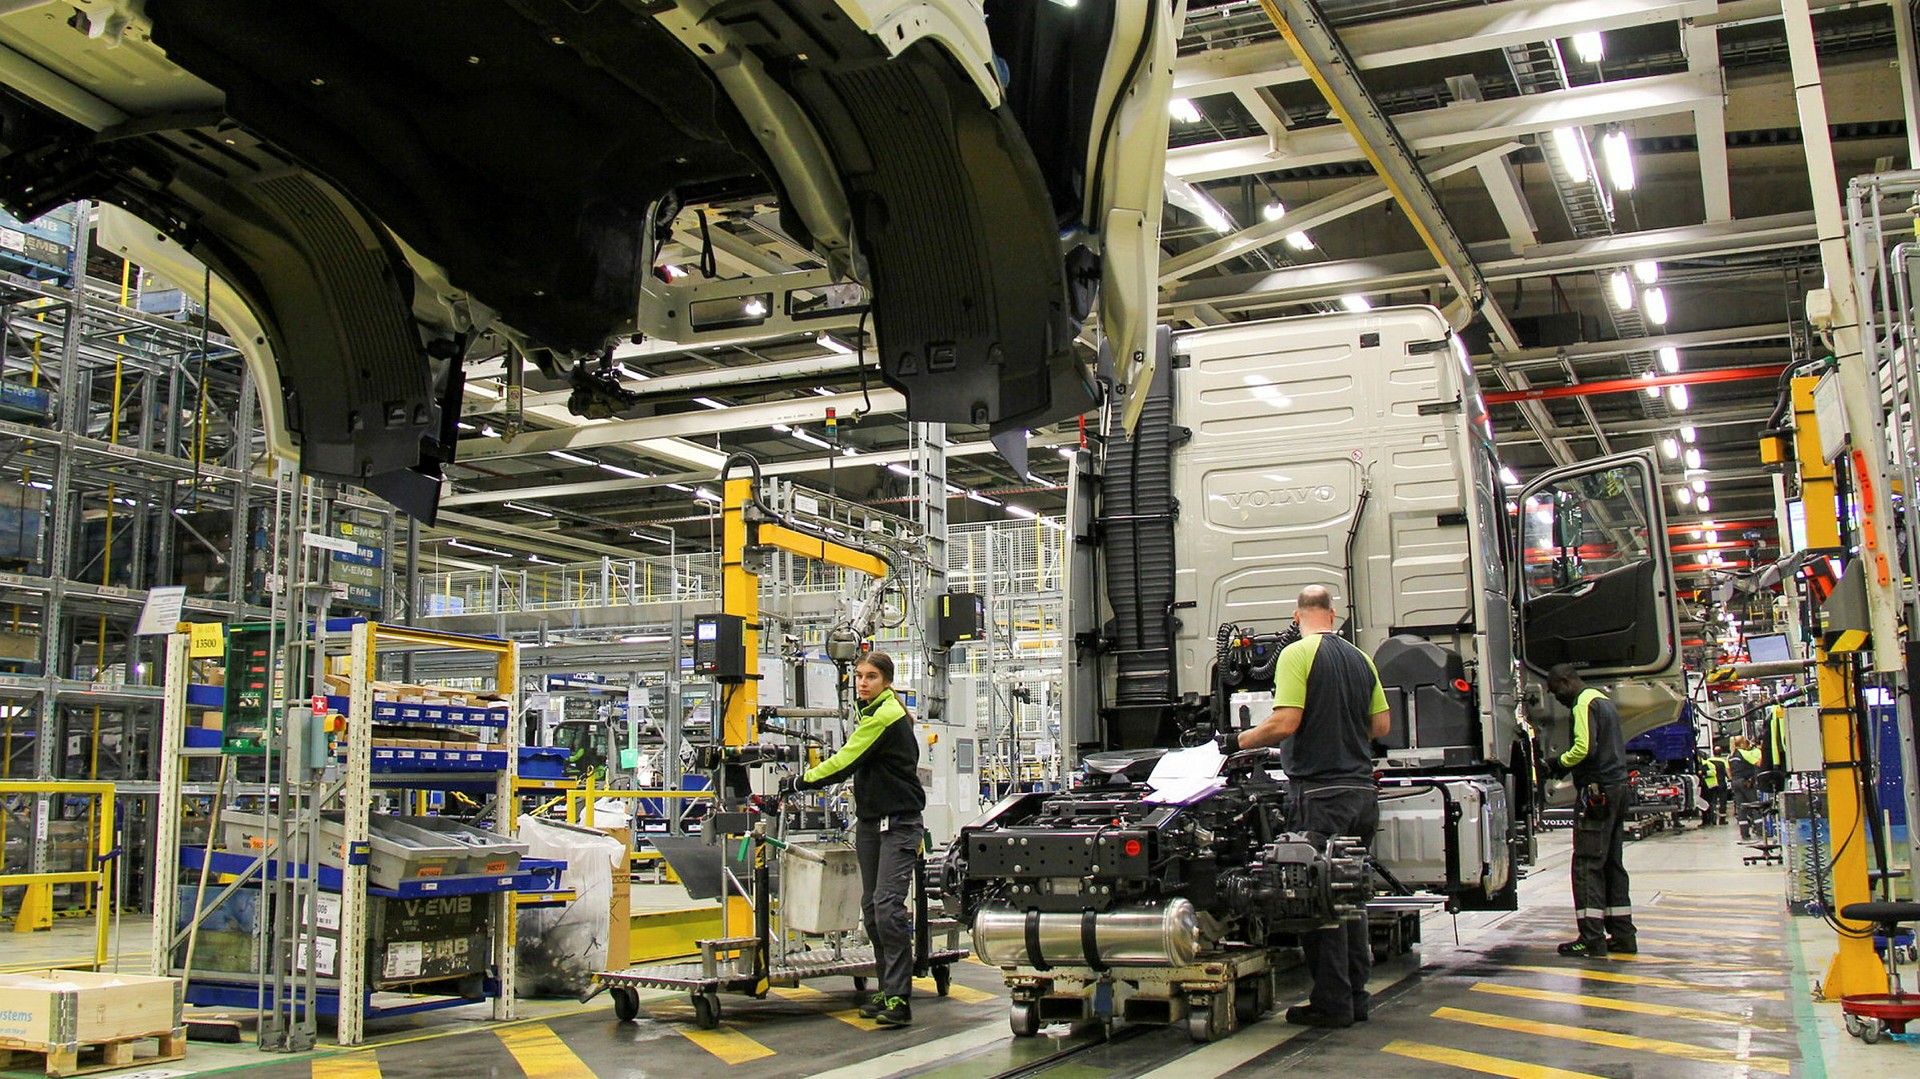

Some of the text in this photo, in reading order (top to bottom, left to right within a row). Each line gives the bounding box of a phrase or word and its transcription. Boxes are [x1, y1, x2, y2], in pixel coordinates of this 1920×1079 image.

[26, 237, 59, 253] EMB
[1221, 484, 1336, 509] VOLVO
[404, 896, 472, 917] V-EMB
[421, 938, 469, 959] EMB
